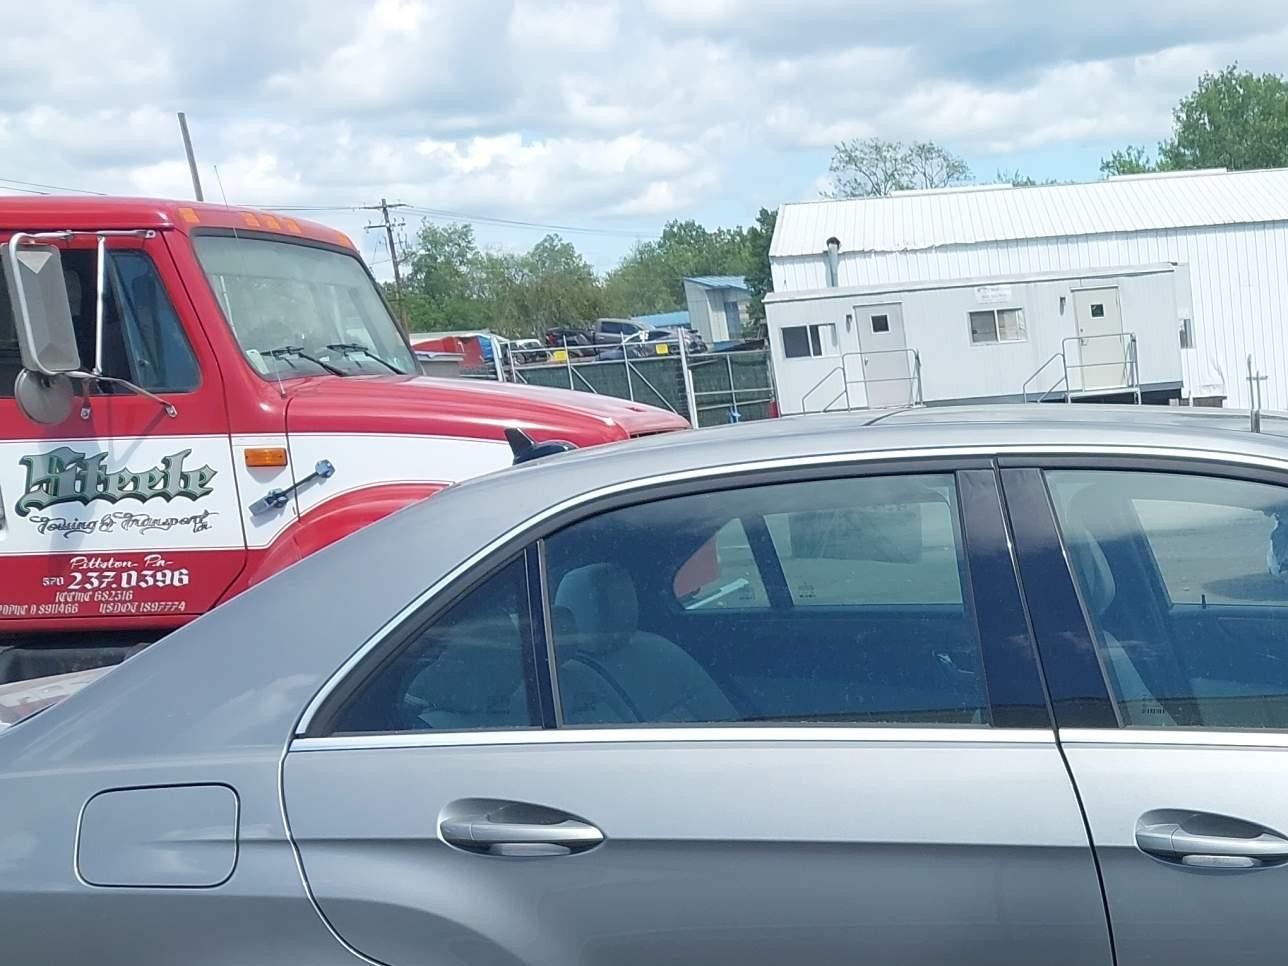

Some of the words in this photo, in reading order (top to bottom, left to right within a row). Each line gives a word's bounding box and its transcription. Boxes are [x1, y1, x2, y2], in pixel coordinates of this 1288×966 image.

[15, 446, 218, 517] Steele
[30, 516, 97, 538] Towing
[113, 510, 219, 535] Transport
[42, 576, 64, 587] 570
[67, 569, 189, 590] 237.0396
